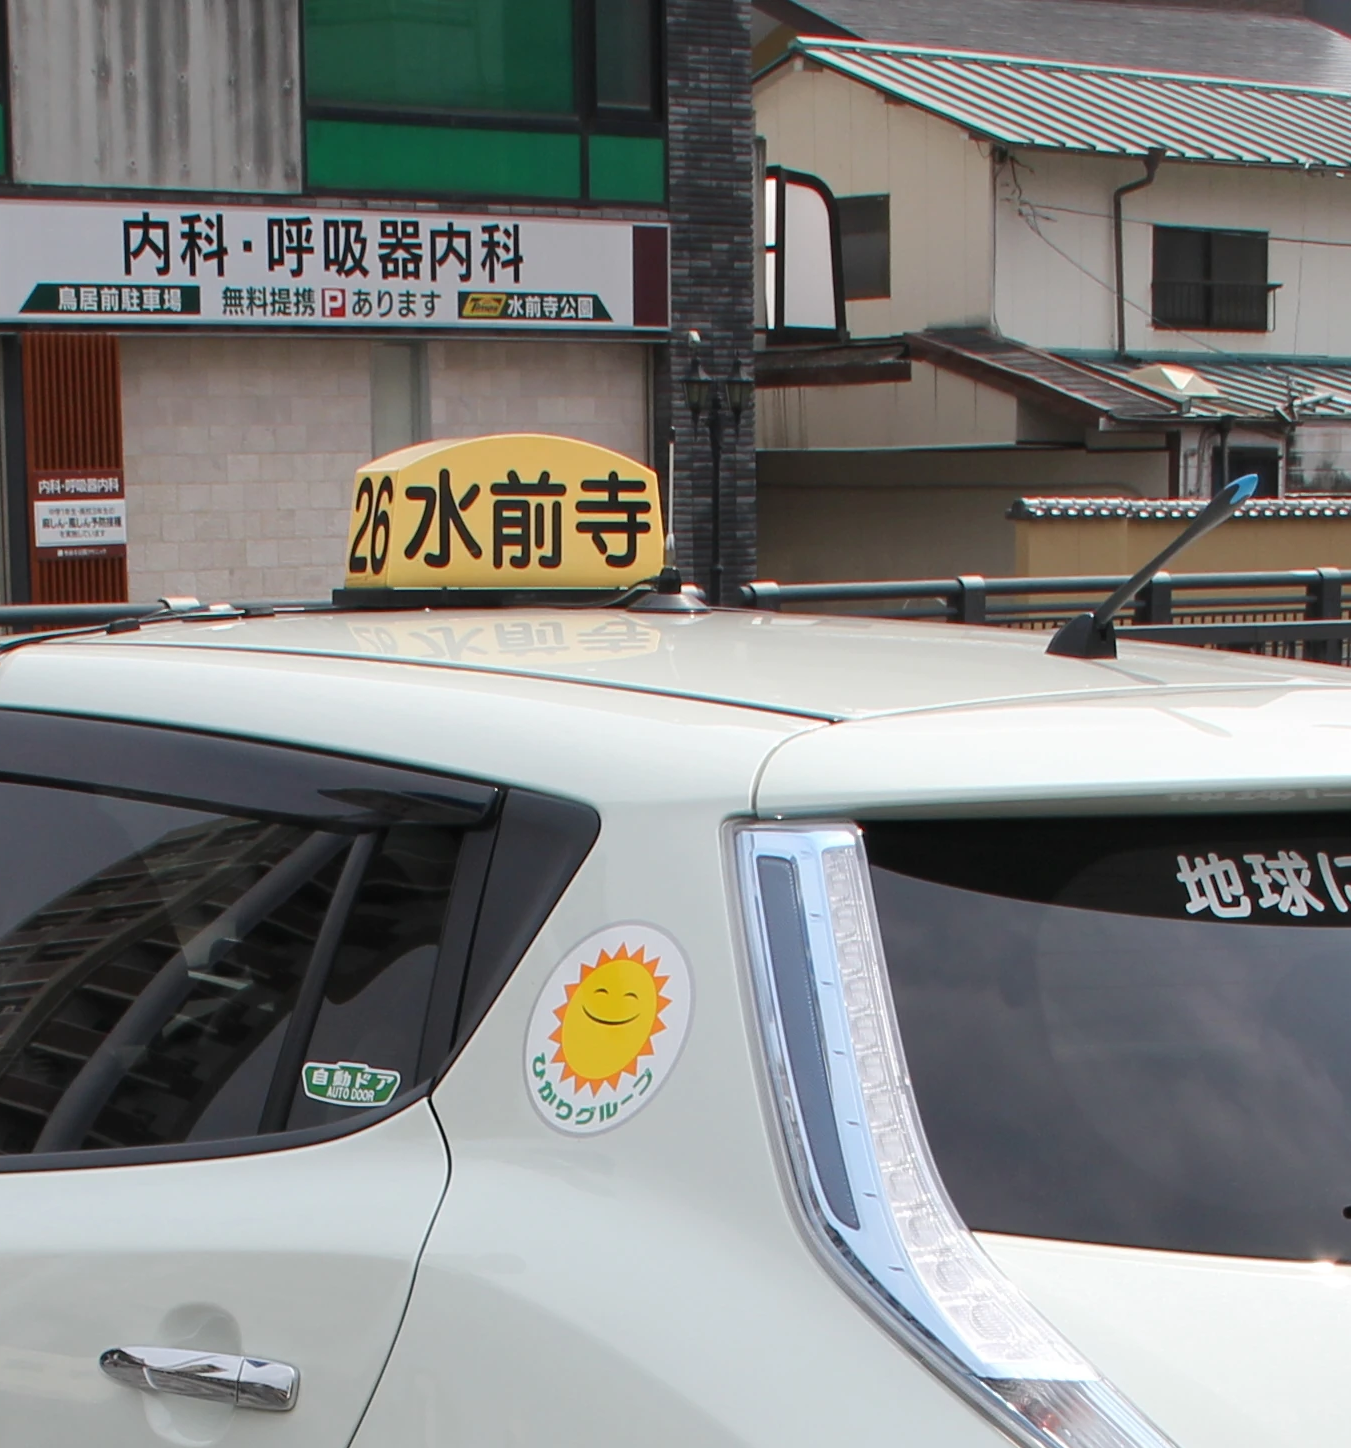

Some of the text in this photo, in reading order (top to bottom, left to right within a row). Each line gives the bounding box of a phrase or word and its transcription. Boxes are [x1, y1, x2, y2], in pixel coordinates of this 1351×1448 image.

[121, 210, 525, 285] 内科・呼吸器内科
[57, 286, 183, 313] 鳥居前駐車場
[506, 293, 595, 321] 水前寺公園
[38, 478, 120, 494] 内科・呼吸器内科
[403, 467, 652, 569] 水前寺
[311, 1068, 396, 1091] 自動ドア
[531, 1051, 654, 1126] ひかりグループ
[326, 1086, 376, 1103] AUTO DOOR
